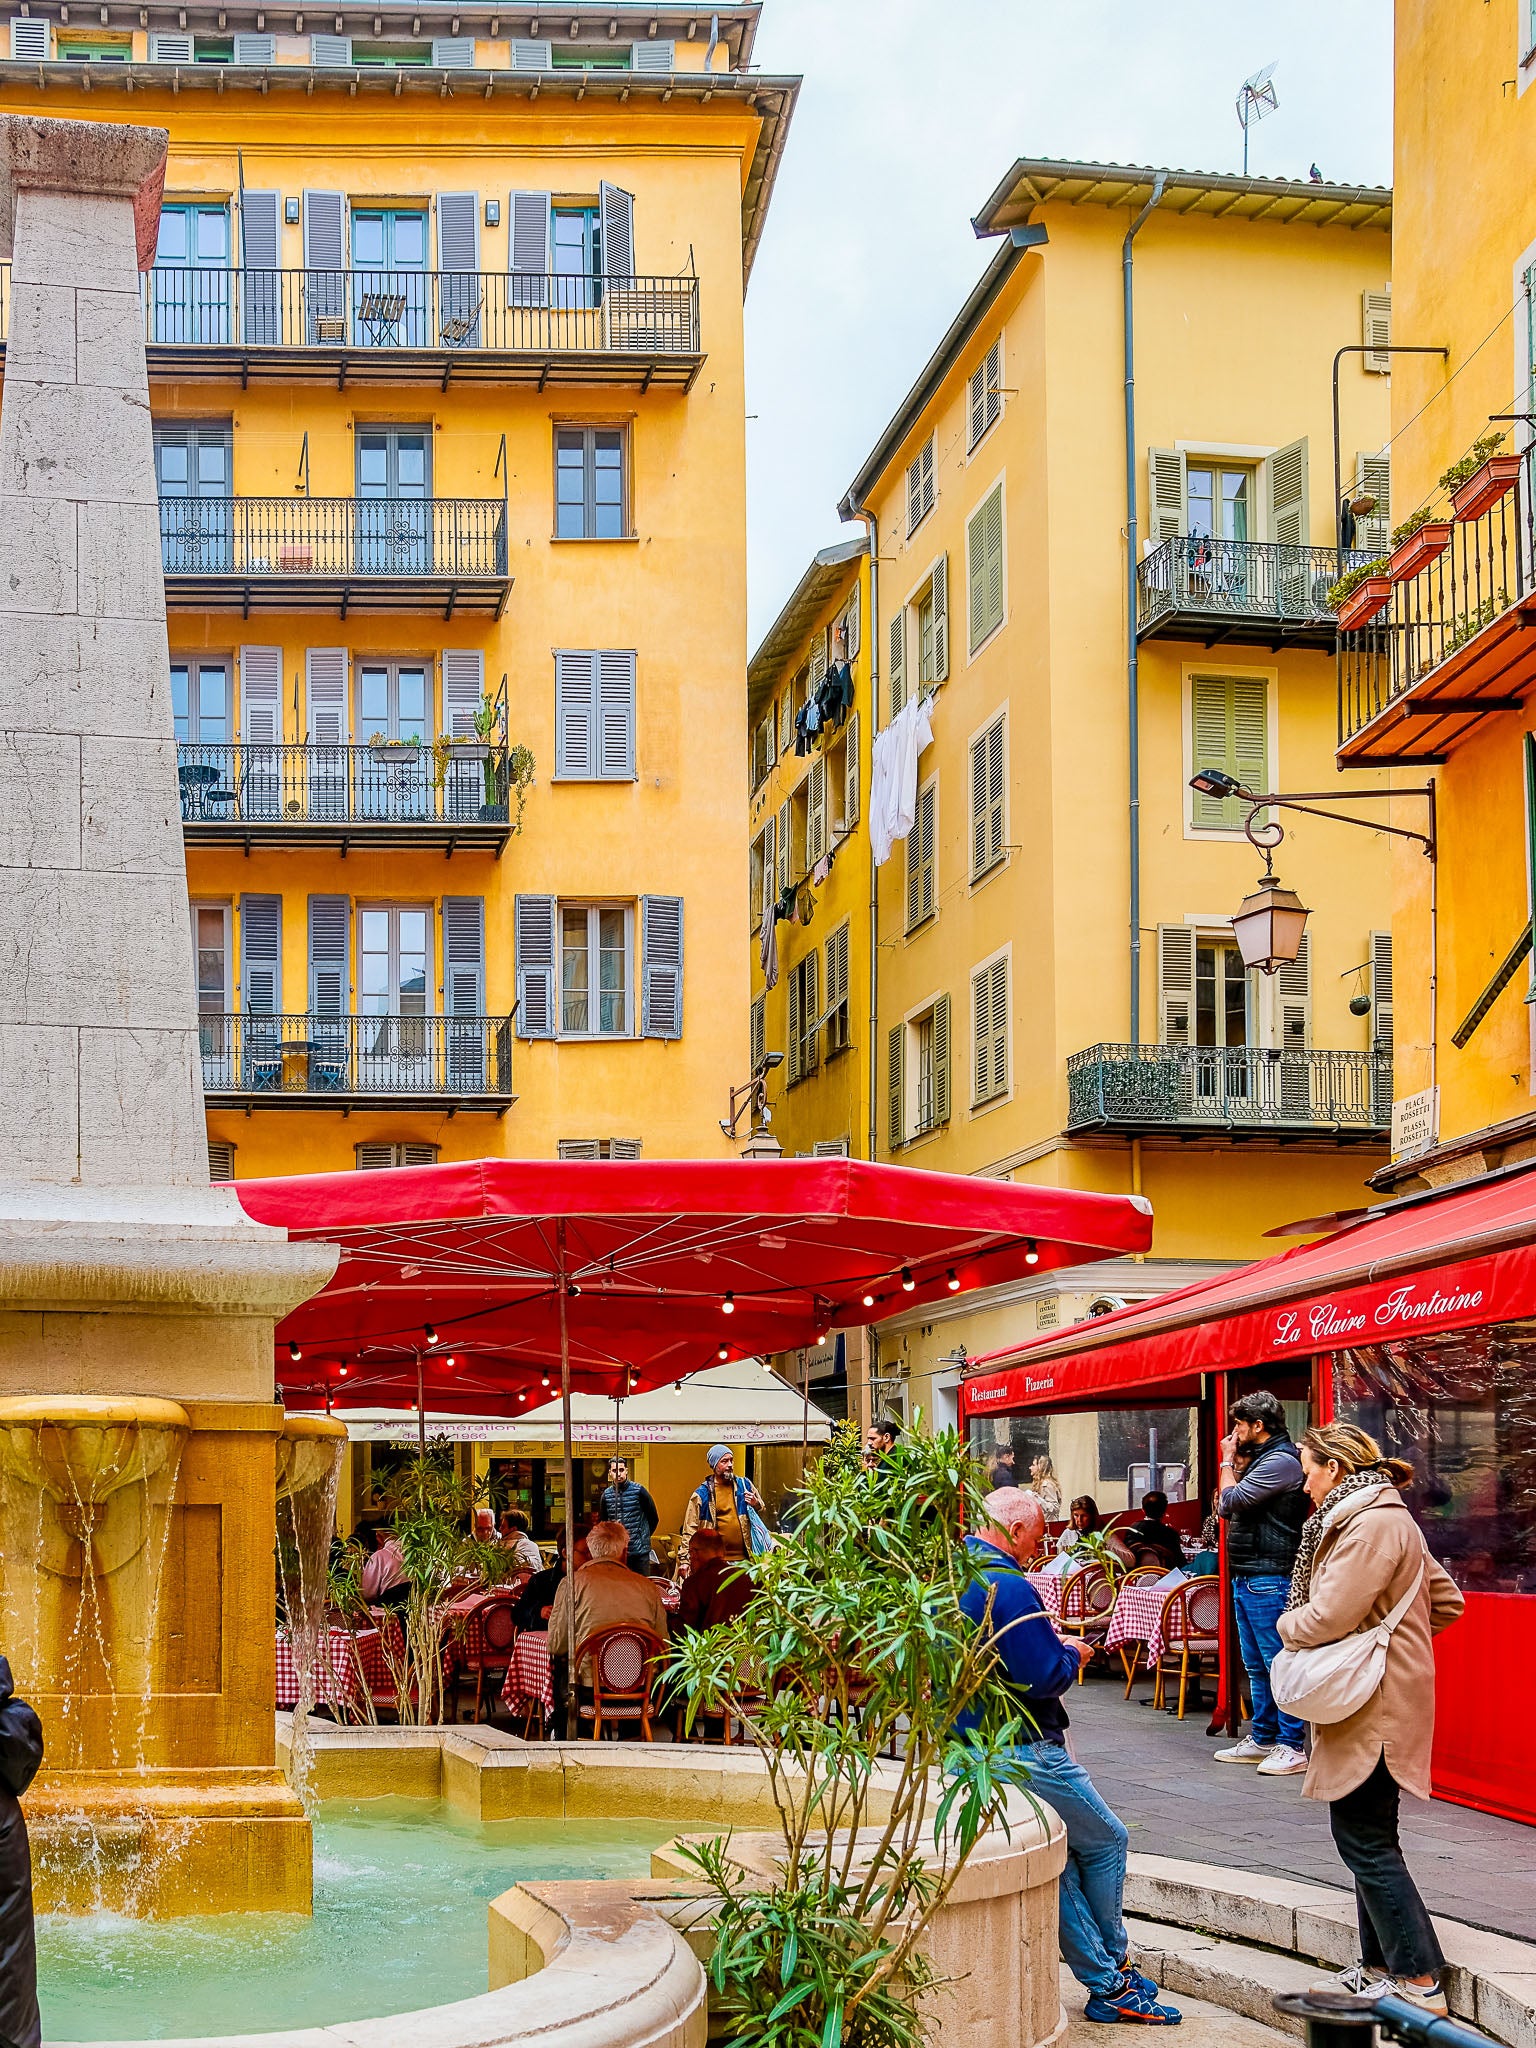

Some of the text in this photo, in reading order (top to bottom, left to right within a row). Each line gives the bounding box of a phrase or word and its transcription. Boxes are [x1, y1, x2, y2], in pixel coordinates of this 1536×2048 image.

[1405, 1096, 1424, 1111] PLACE
[1400, 1104, 1430, 1123] ROSSETTI
[1403, 1119, 1426, 1134] PLASSA
[1399, 1127, 1430, 1146] ROSSETTI
[1273, 1284, 1483, 1345] La Claire Fontaine
[971, 1374, 1054, 1402] Restaurant Pizzeria
[455, 1432, 488, 1440] 1966
